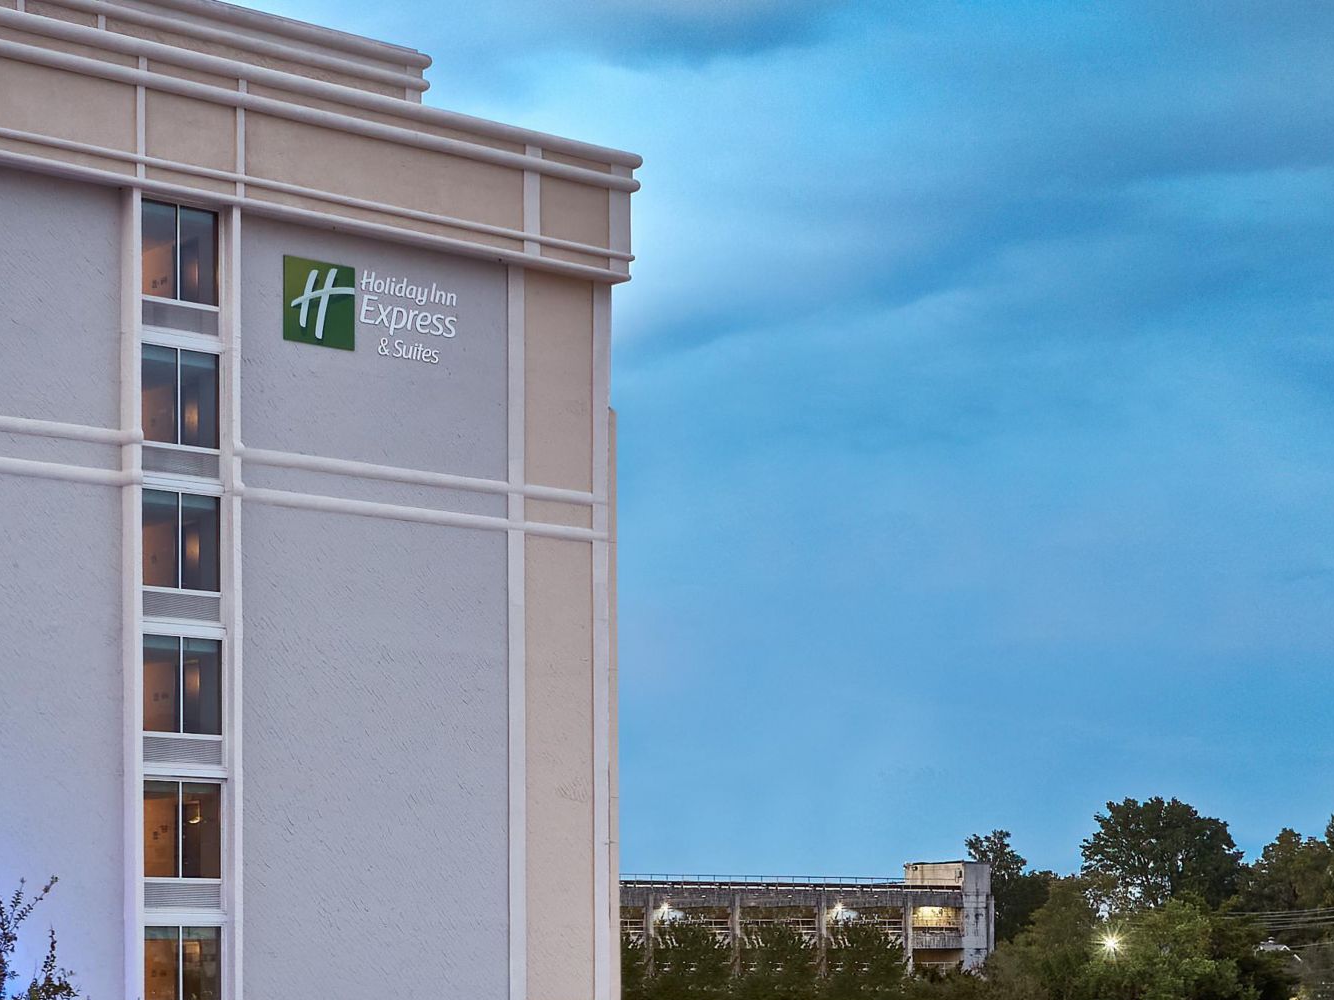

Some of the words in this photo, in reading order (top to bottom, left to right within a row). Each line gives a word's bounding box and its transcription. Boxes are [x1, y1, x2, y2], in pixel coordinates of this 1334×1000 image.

[360, 269, 428, 306] Holiday
[430, 283, 457, 307] Inn
[359, 294, 458, 338] Express
[378, 337, 390, 356] &
[392, 339, 440, 365] Suites
